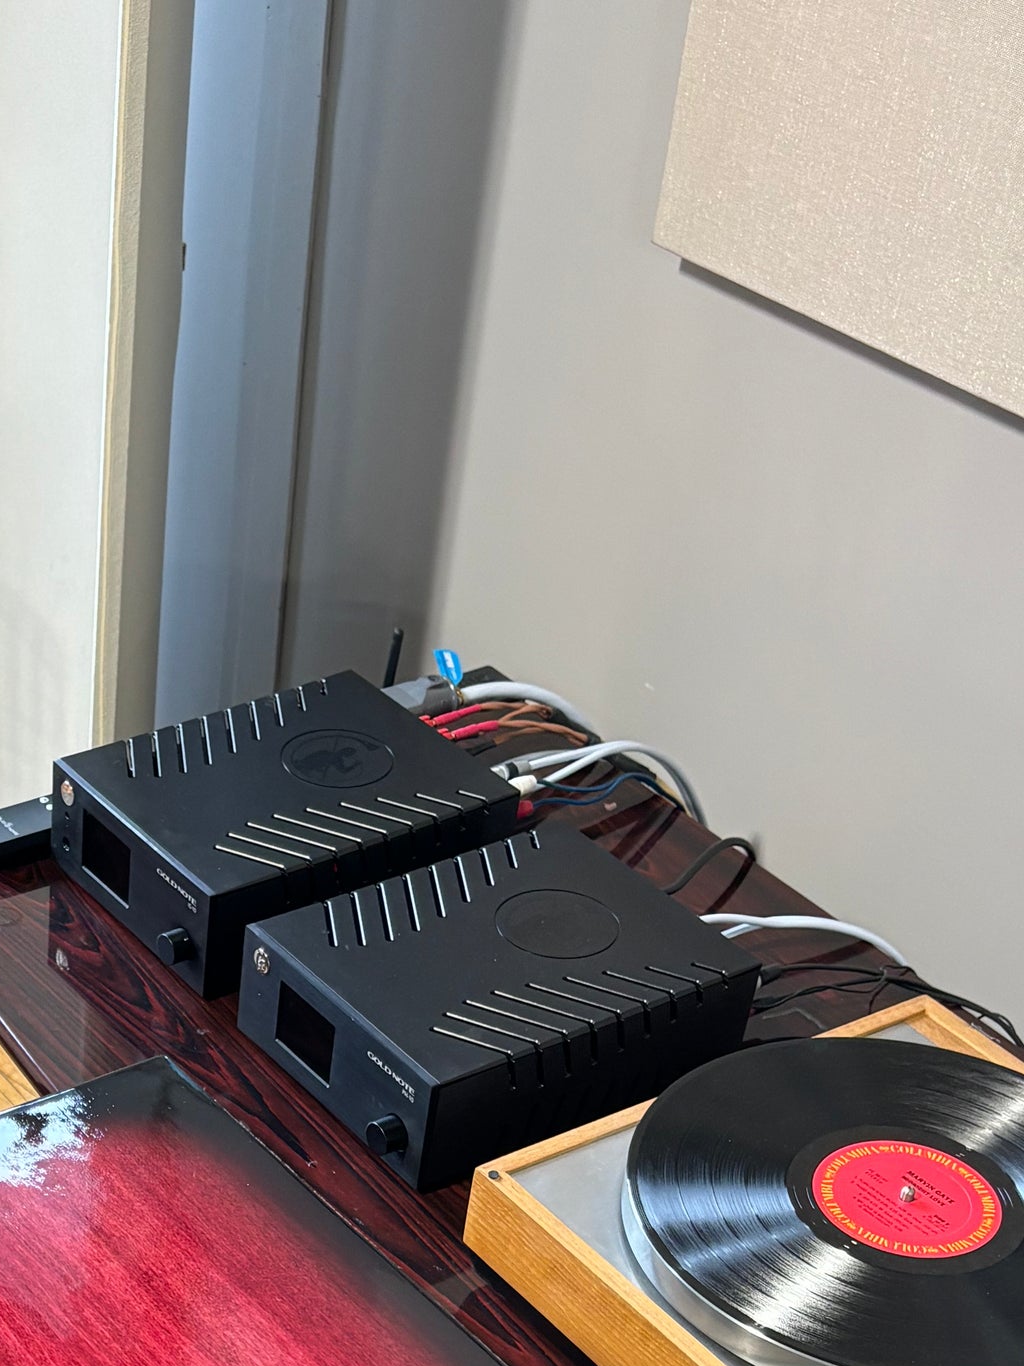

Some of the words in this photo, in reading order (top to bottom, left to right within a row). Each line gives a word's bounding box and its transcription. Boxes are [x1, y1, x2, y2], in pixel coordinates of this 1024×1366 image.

[156, 867, 178, 889] GOLD
[177, 885, 197, 908] NOTE
[367, 1050, 392, 1075] GOLD
[392, 1072, 415, 1097] NOTE
[824, 1146, 881, 1175] COLUMBIA
[890, 1145, 958, 1171] COLUMBIA
[820, 1180, 853, 1225] COLUMBIA
[963, 1173, 996, 1217] COLUMBIA
[857, 1227, 928, 1254] COLUMBIA
[937, 1221, 992, 1253] COLUMBIA
